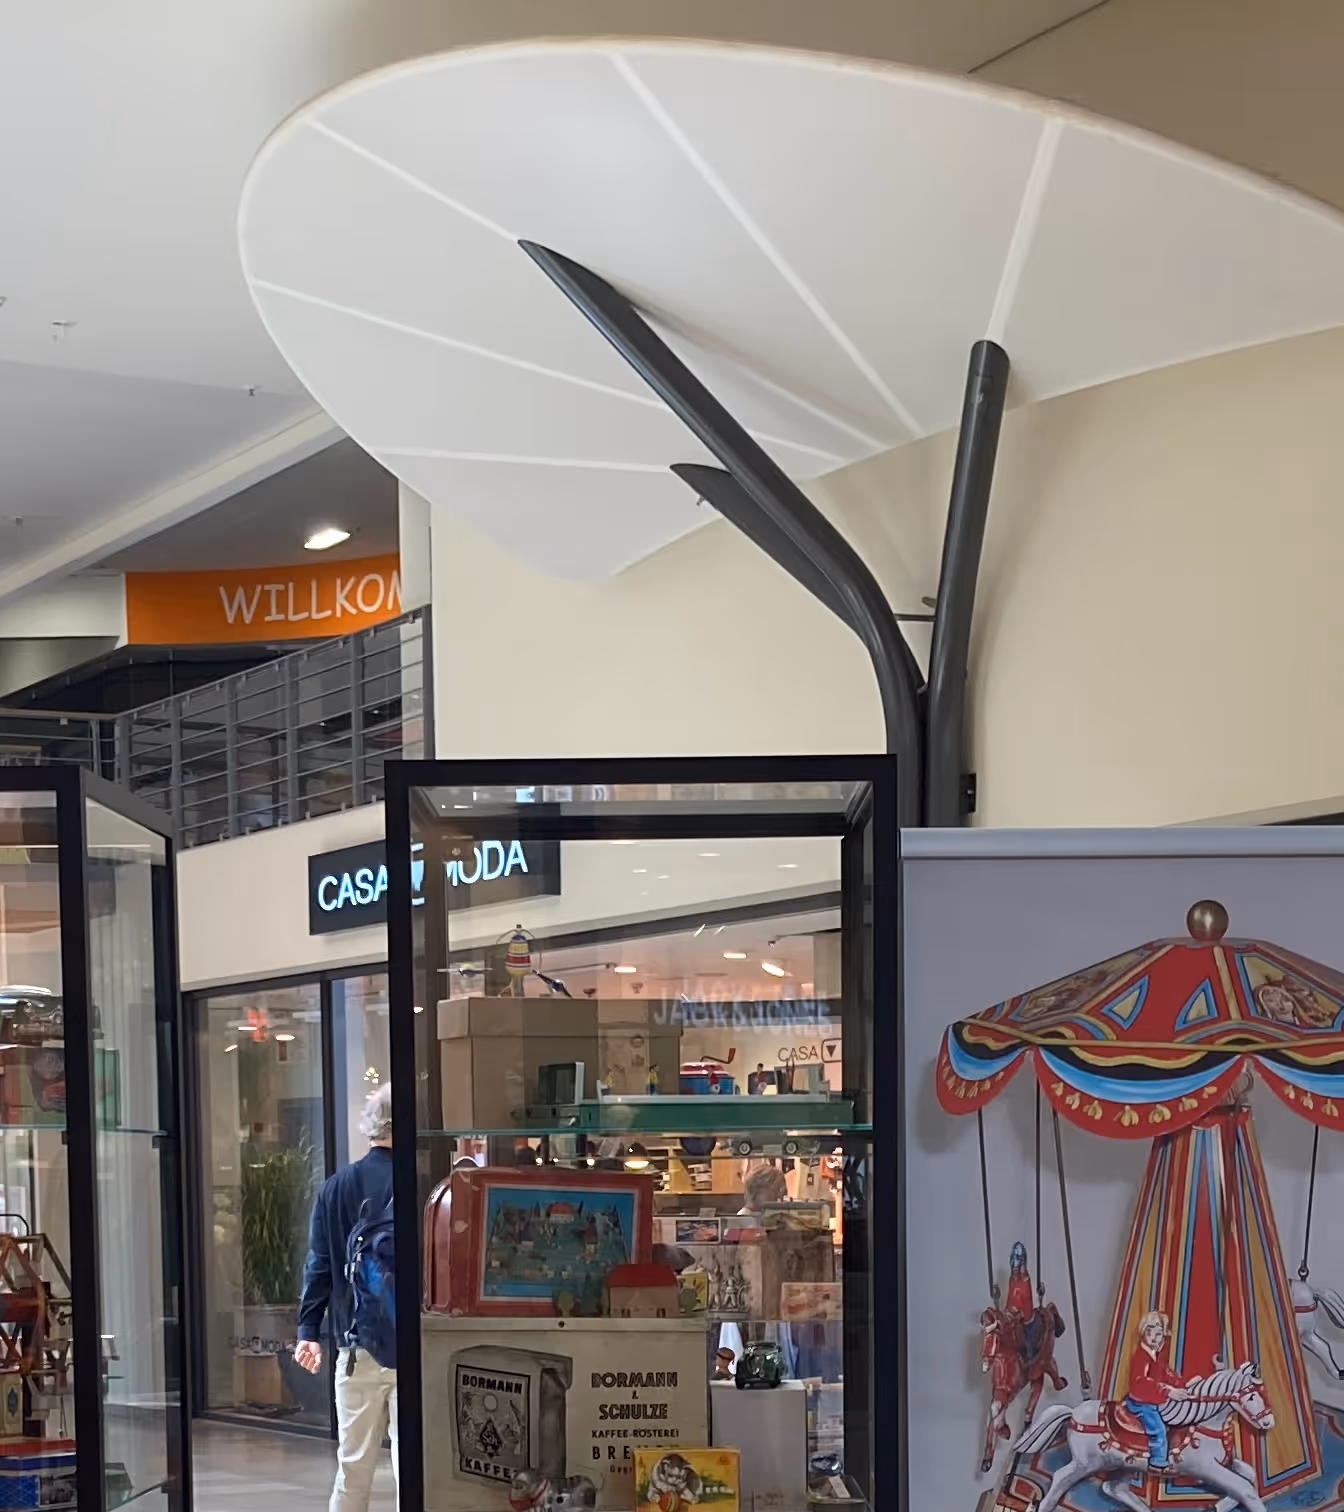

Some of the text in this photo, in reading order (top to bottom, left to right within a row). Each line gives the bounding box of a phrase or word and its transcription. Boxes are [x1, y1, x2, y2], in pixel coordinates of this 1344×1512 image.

[317, 864, 388, 912] CASA
[777, 1045, 818, 1062] CASA
[461, 1374, 523, 1395] BORMANN
[591, 1371, 678, 1388] BORMANN
[599, 1403, 668, 1420] SCHULZE
